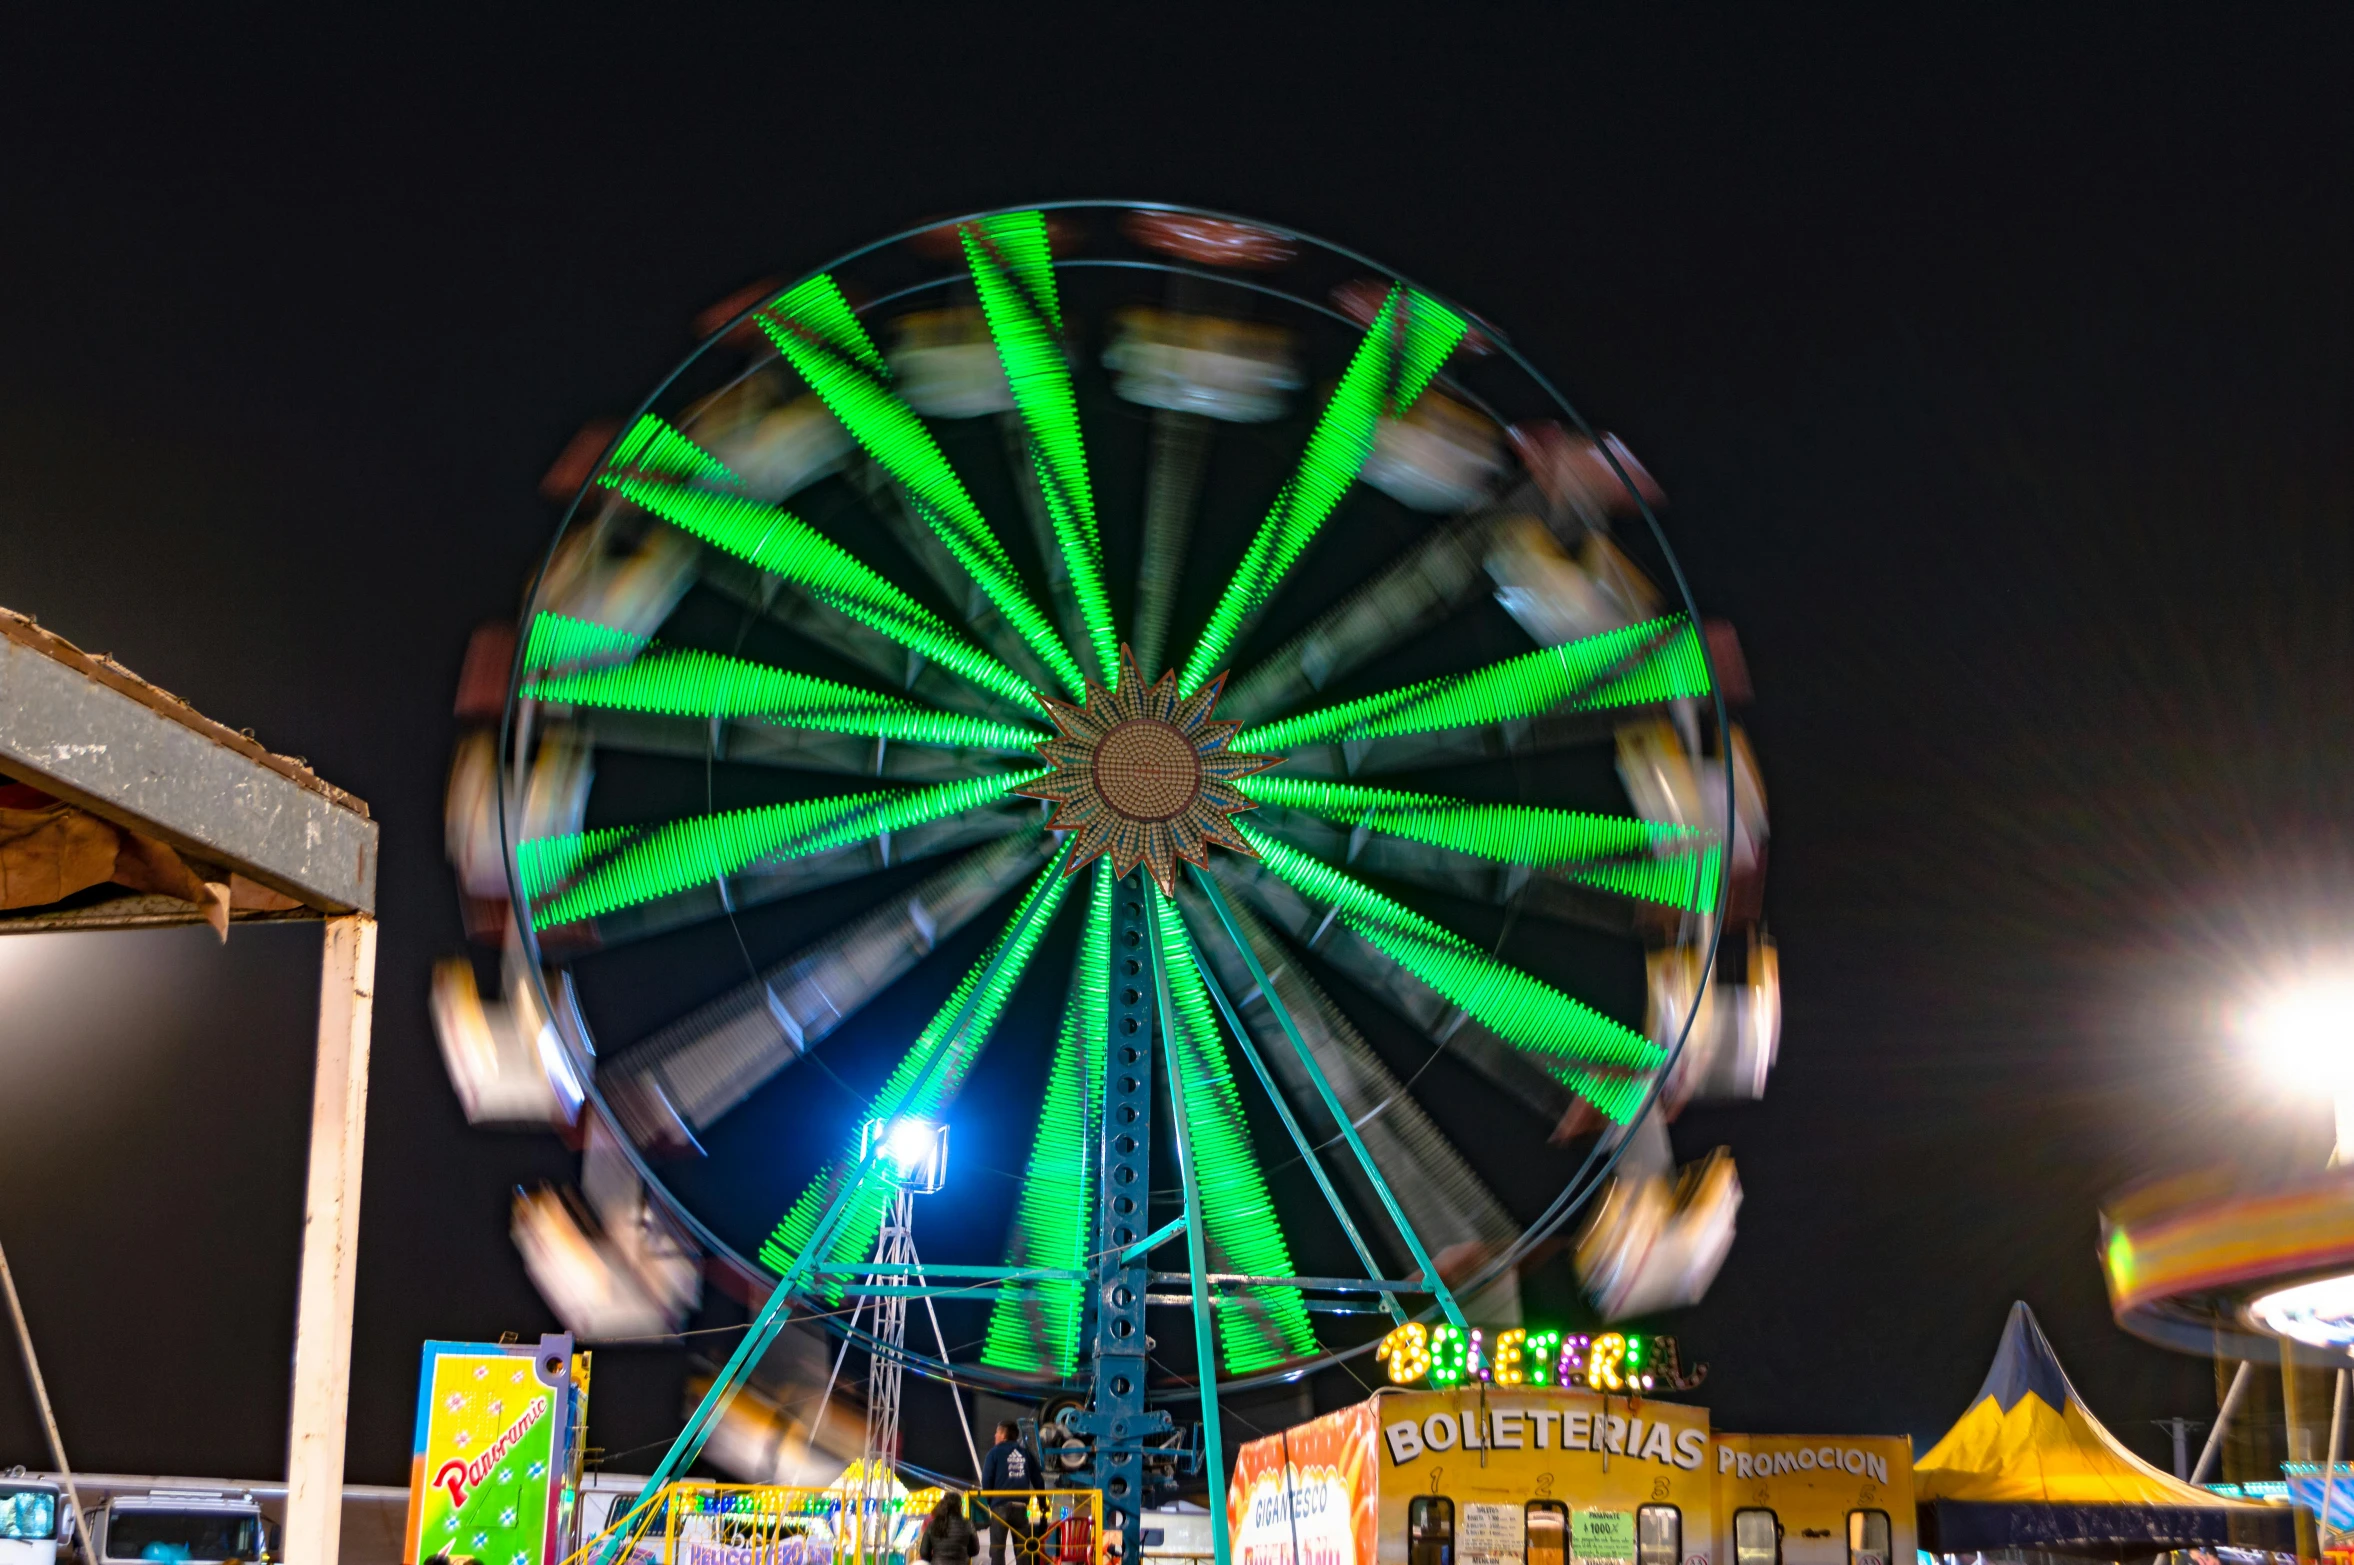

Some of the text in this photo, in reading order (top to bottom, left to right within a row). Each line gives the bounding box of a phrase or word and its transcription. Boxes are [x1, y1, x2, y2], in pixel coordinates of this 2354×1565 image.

[1376, 1322, 1709, 1390] BOLETERIA
[433, 1396, 547, 1508] Panoramic
[1385, 1409, 1708, 1470] BOLETERIAS
[1430, 1466, 1443, 1494] 1
[1535, 1472, 1554, 1497] 2
[1717, 1445, 1888, 1485] PROMOCION
[1256, 1482, 1328, 1529] GIGANTESCO
[1651, 1476, 1670, 1500] 3
[1752, 1482, 1770, 1506] 4
